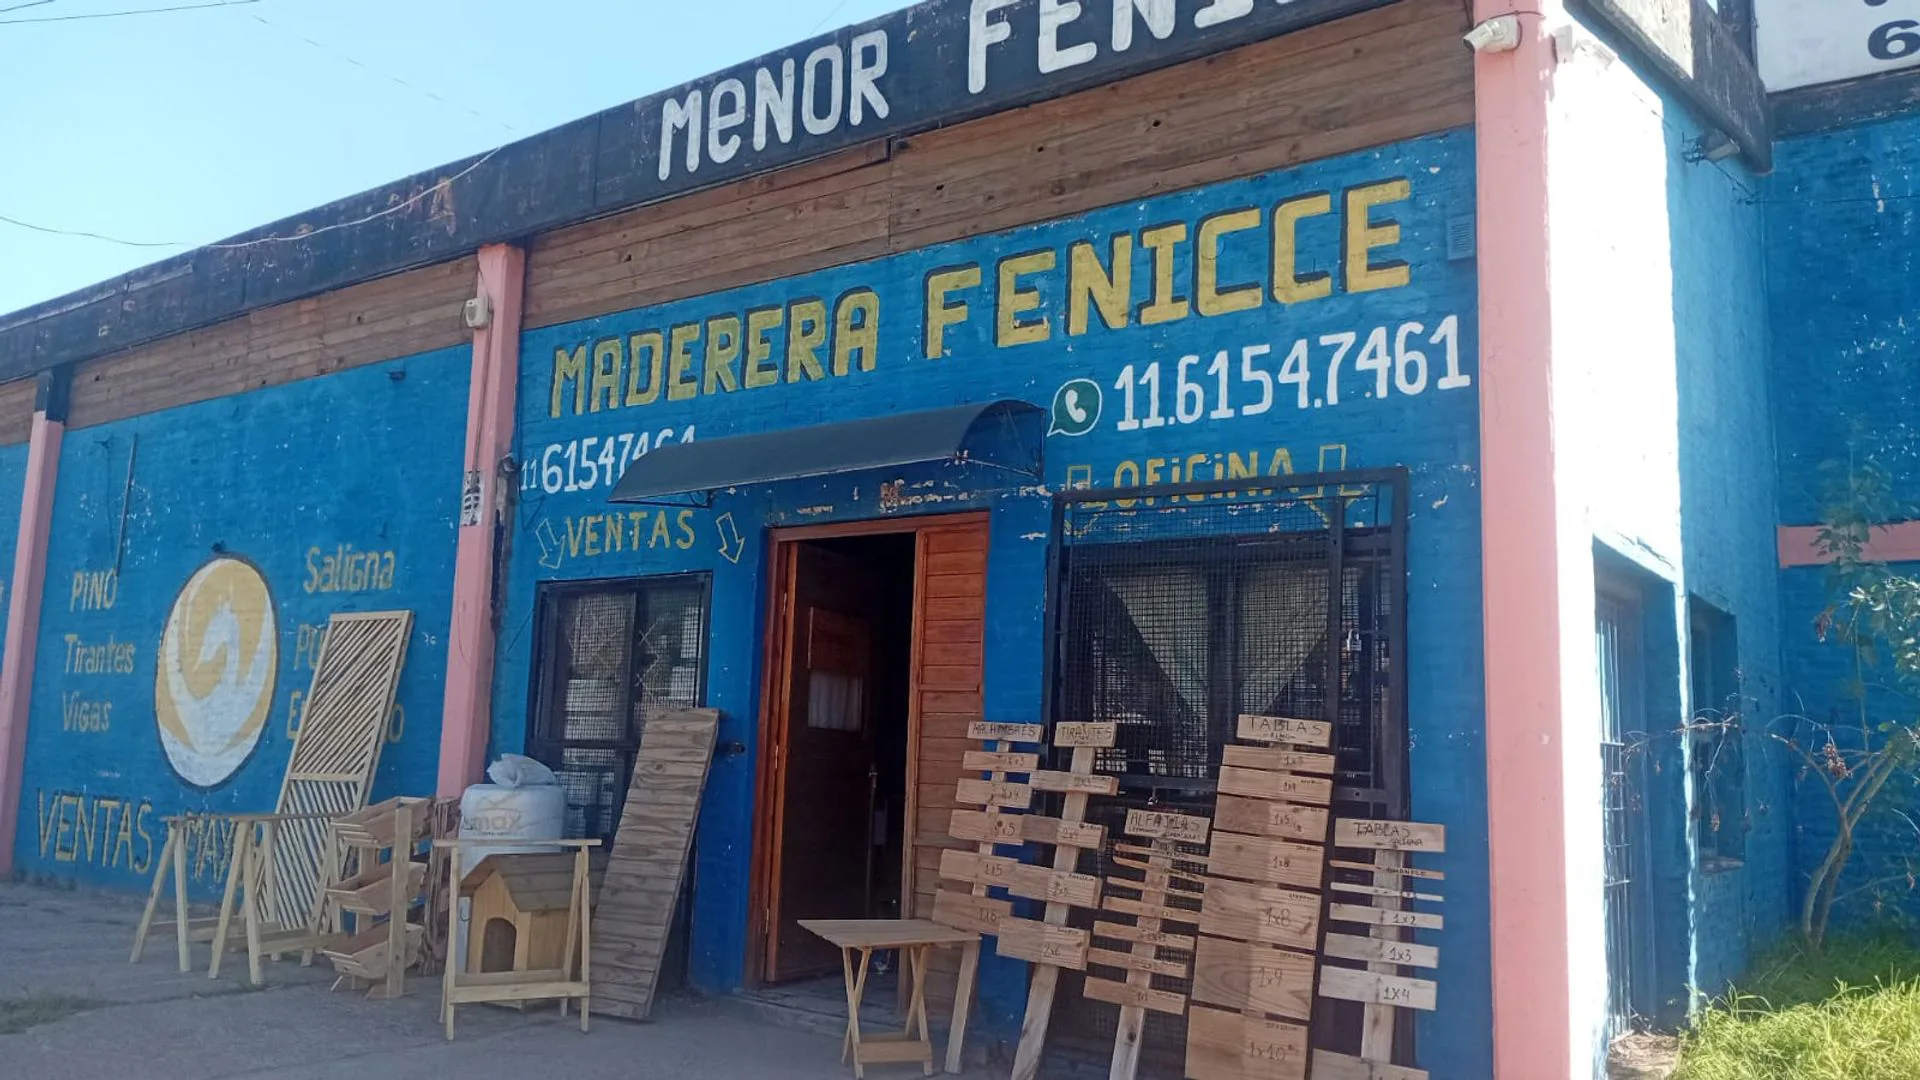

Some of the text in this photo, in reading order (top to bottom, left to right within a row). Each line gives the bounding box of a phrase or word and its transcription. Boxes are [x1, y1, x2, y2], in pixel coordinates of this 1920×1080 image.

[550, 180, 1411, 418] MADERERA FENICCE
[566, 510, 696, 558] VENTAS
[303, 544, 395, 594] Saligna
[64, 633, 136, 675] Tirantes
[1247, 716, 1323, 737] TABLAS
[37, 788, 153, 874] VENTAS
[1353, 821, 1412, 839] TABLAS
[1264, 905, 1292, 929] 1x8
[1391, 912, 1417, 926] 1x2
[1388, 946, 1413, 963] 1x3
[1256, 965, 1285, 989] 1x9
